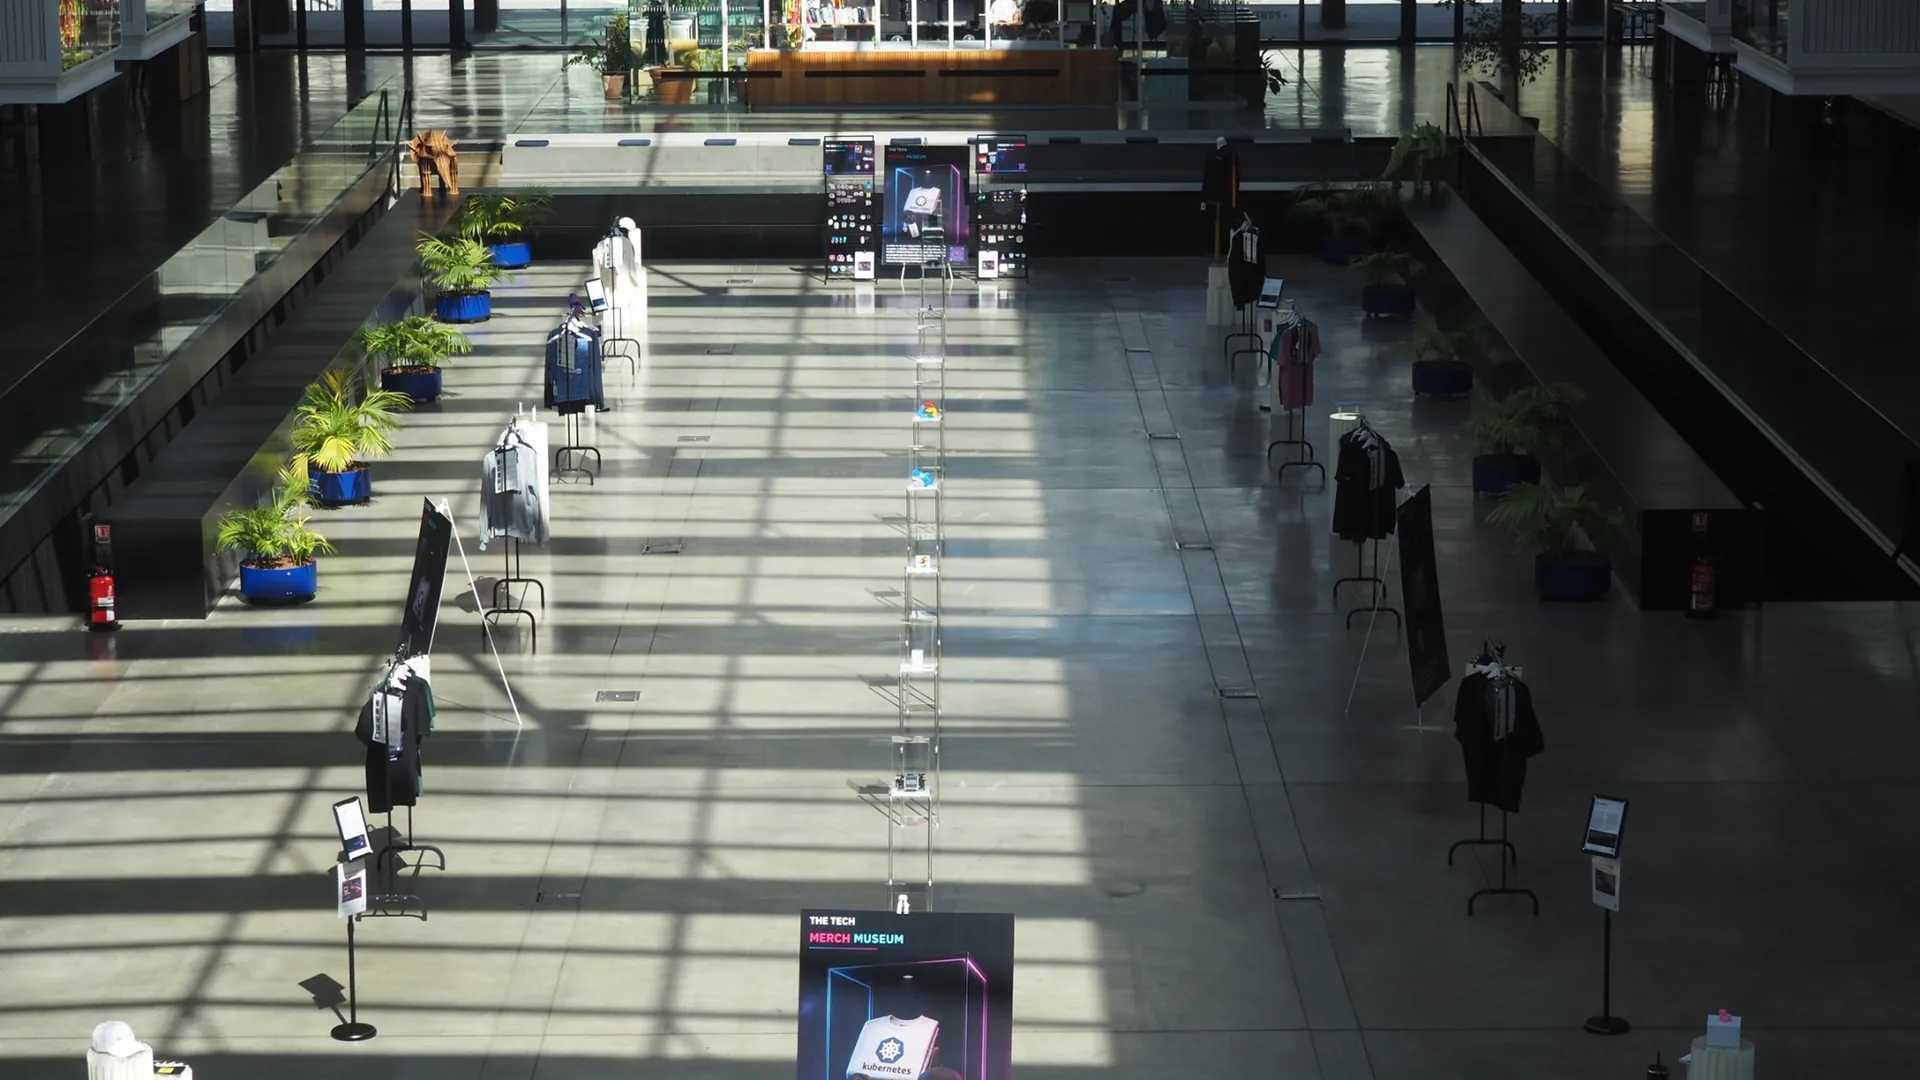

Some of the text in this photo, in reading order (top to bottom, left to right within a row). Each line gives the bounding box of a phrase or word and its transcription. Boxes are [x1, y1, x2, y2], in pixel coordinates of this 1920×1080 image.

[810, 916, 856, 926] THE TECH
[809, 932, 904, 944] MERCH MUSEUM
[862, 1062, 911, 1075] kubernetes
